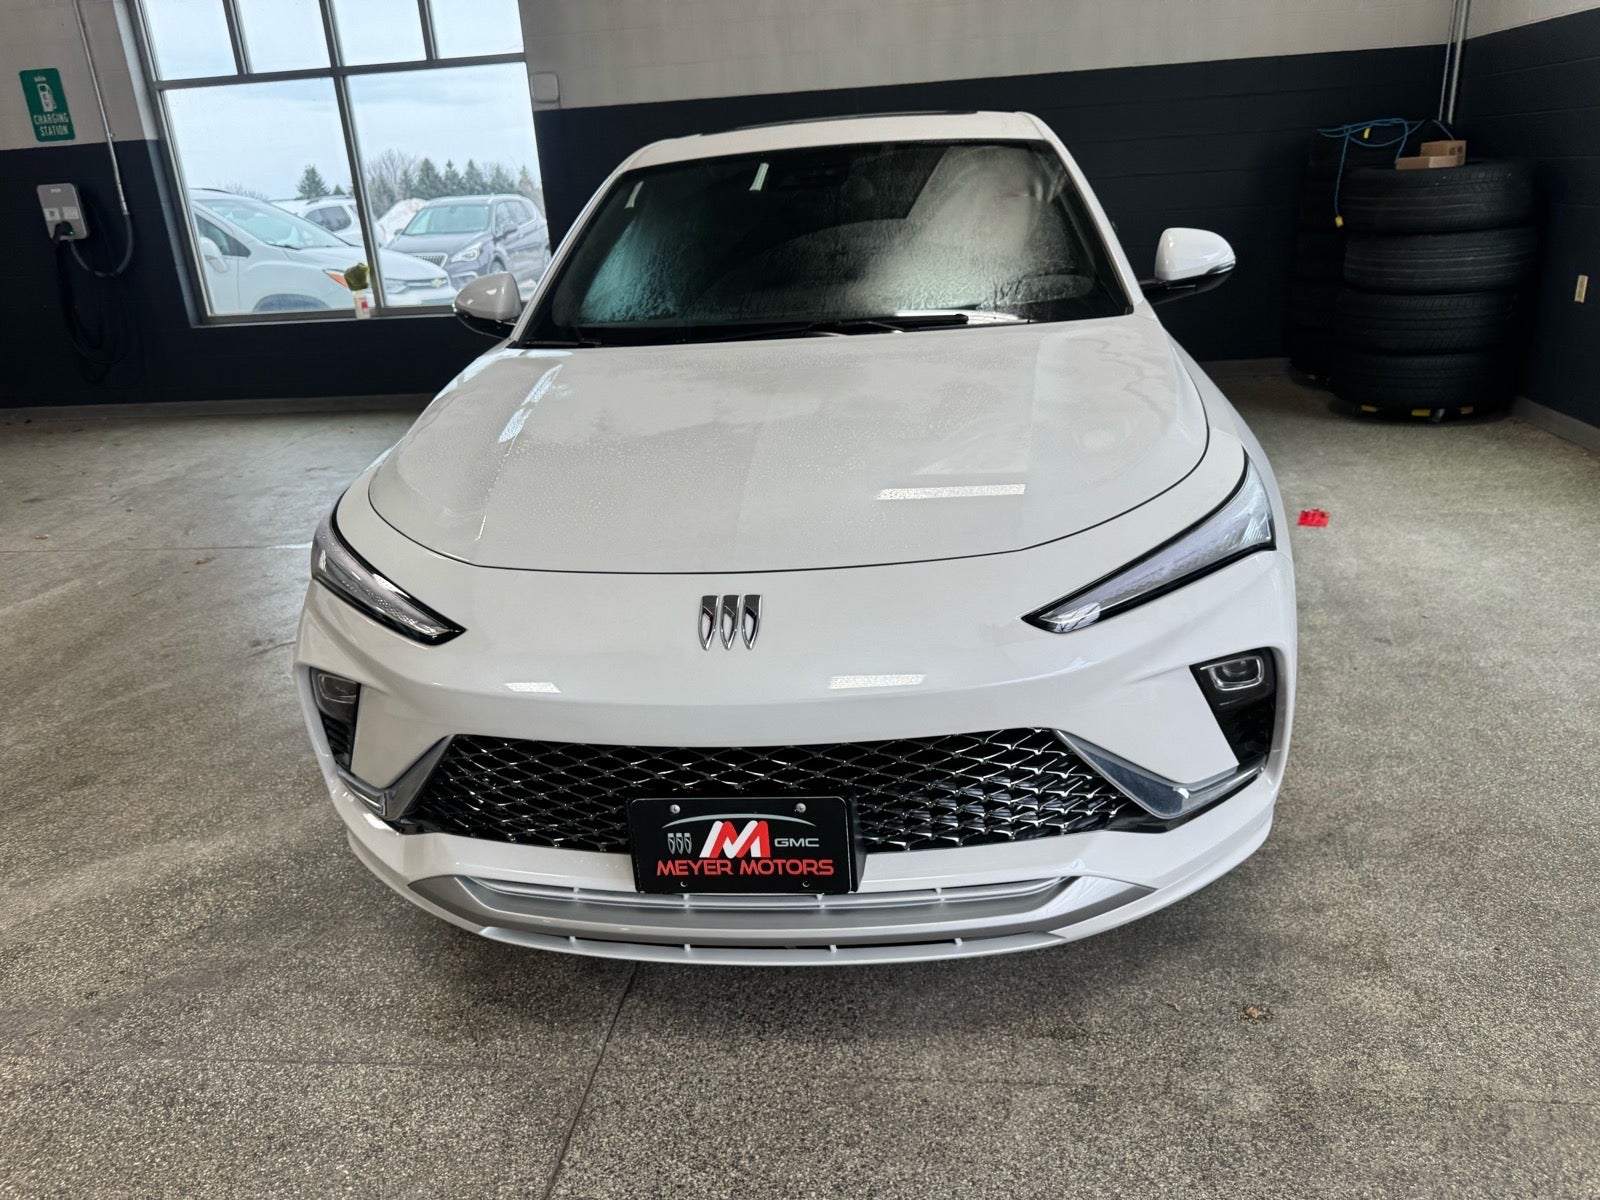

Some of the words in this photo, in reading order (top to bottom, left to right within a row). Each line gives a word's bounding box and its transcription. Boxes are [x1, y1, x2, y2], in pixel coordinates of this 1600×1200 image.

[34, 113, 69, 125] CHARGING
[40, 125, 69, 136] STATION
[774, 837, 820, 848] GMC
[657, 860, 733, 876] MEYER
[740, 860, 834, 875] MOTORS
